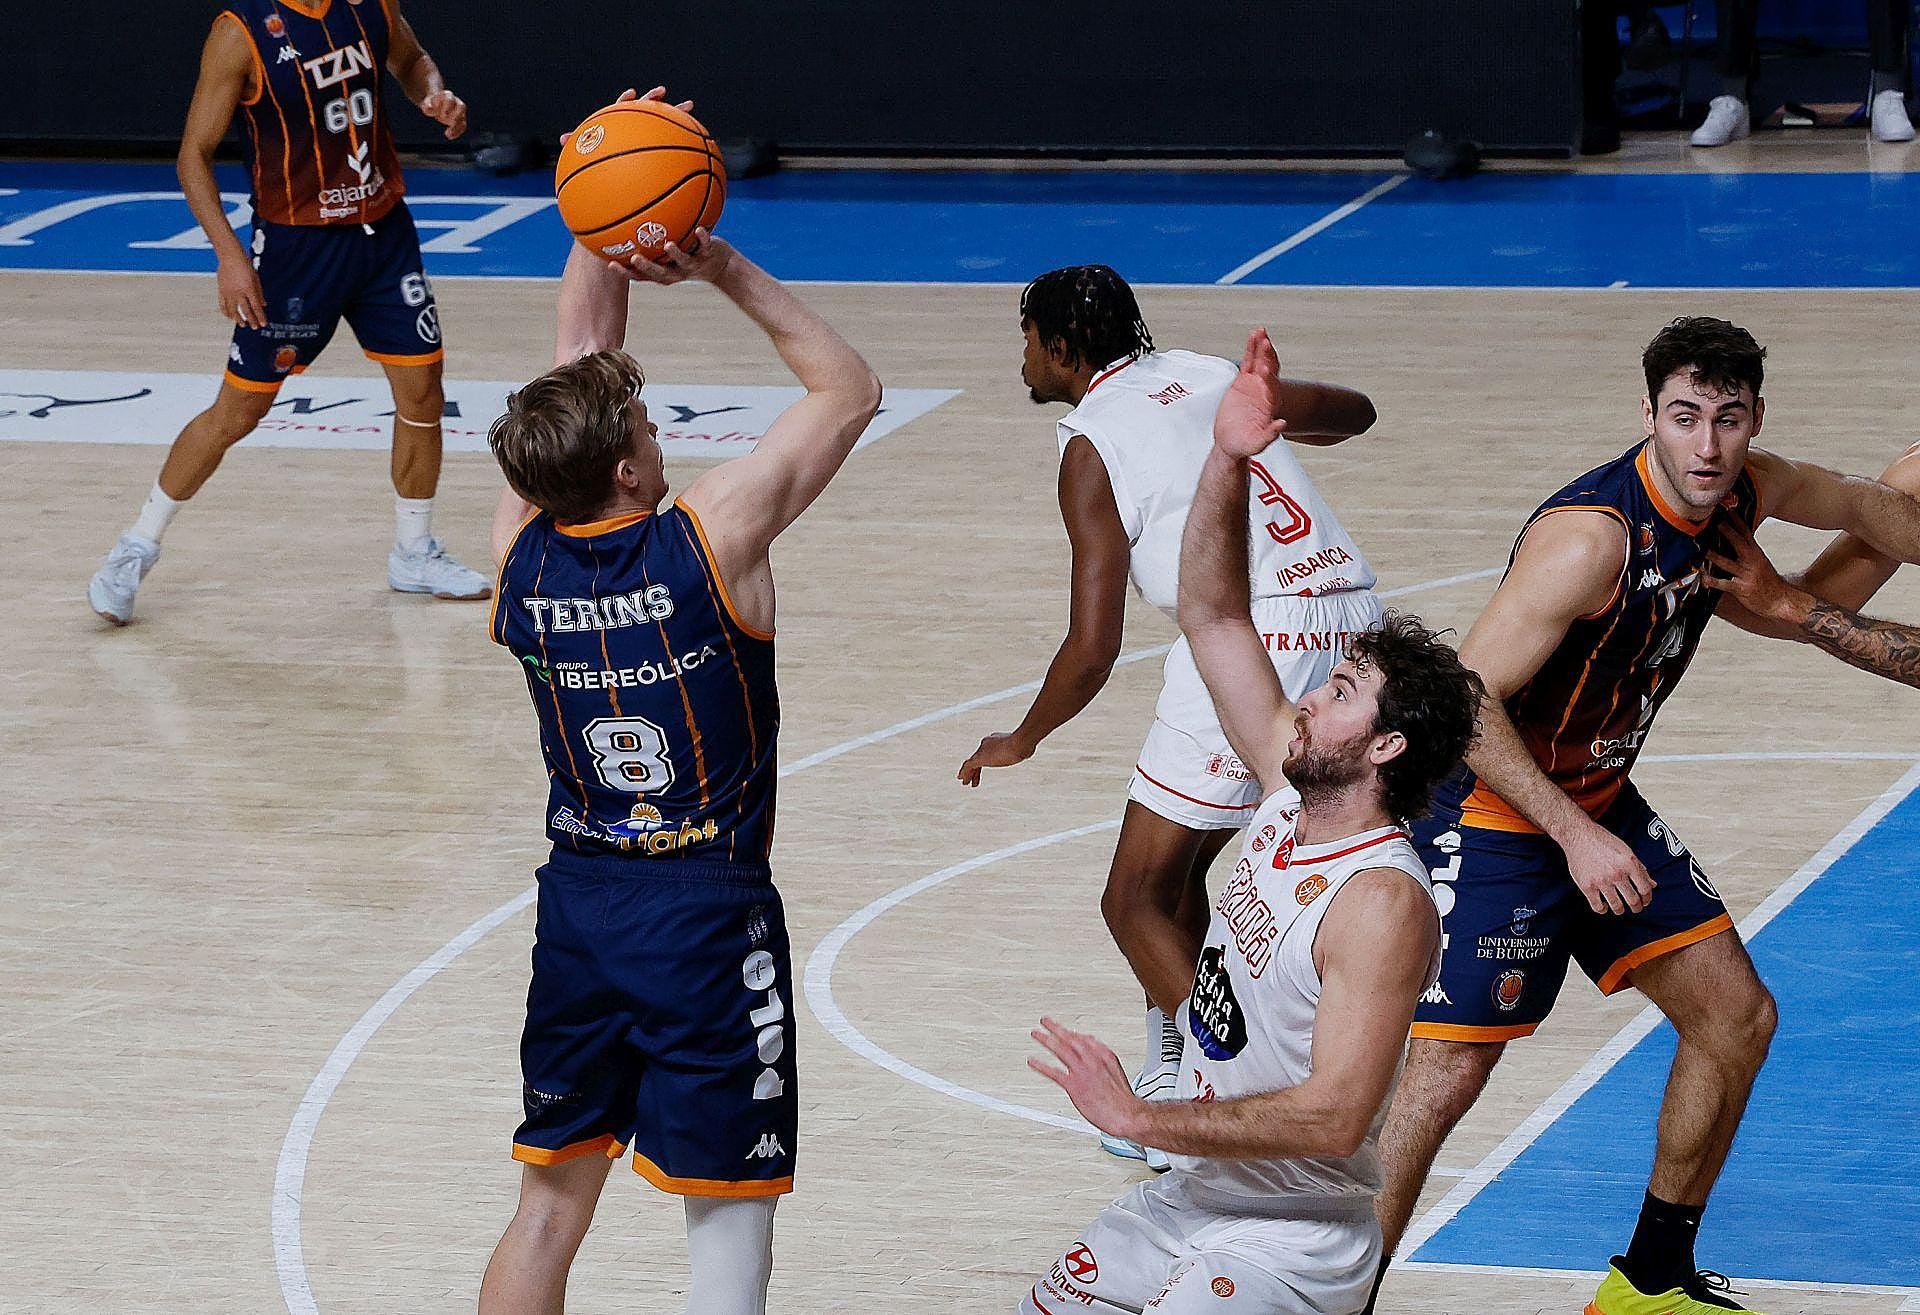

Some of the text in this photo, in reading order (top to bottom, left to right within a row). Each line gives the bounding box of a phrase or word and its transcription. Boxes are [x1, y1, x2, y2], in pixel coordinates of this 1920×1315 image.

[303, 40, 372, 90] TZN
[324, 88, 374, 135] 60
[523, 584, 674, 633] TERINS
[556, 661, 589, 671] GRUPO
[559, 645, 717, 689] IBEREÓLICA
[582, 716, 675, 796] 8
[1477, 949, 1494, 959] DE
